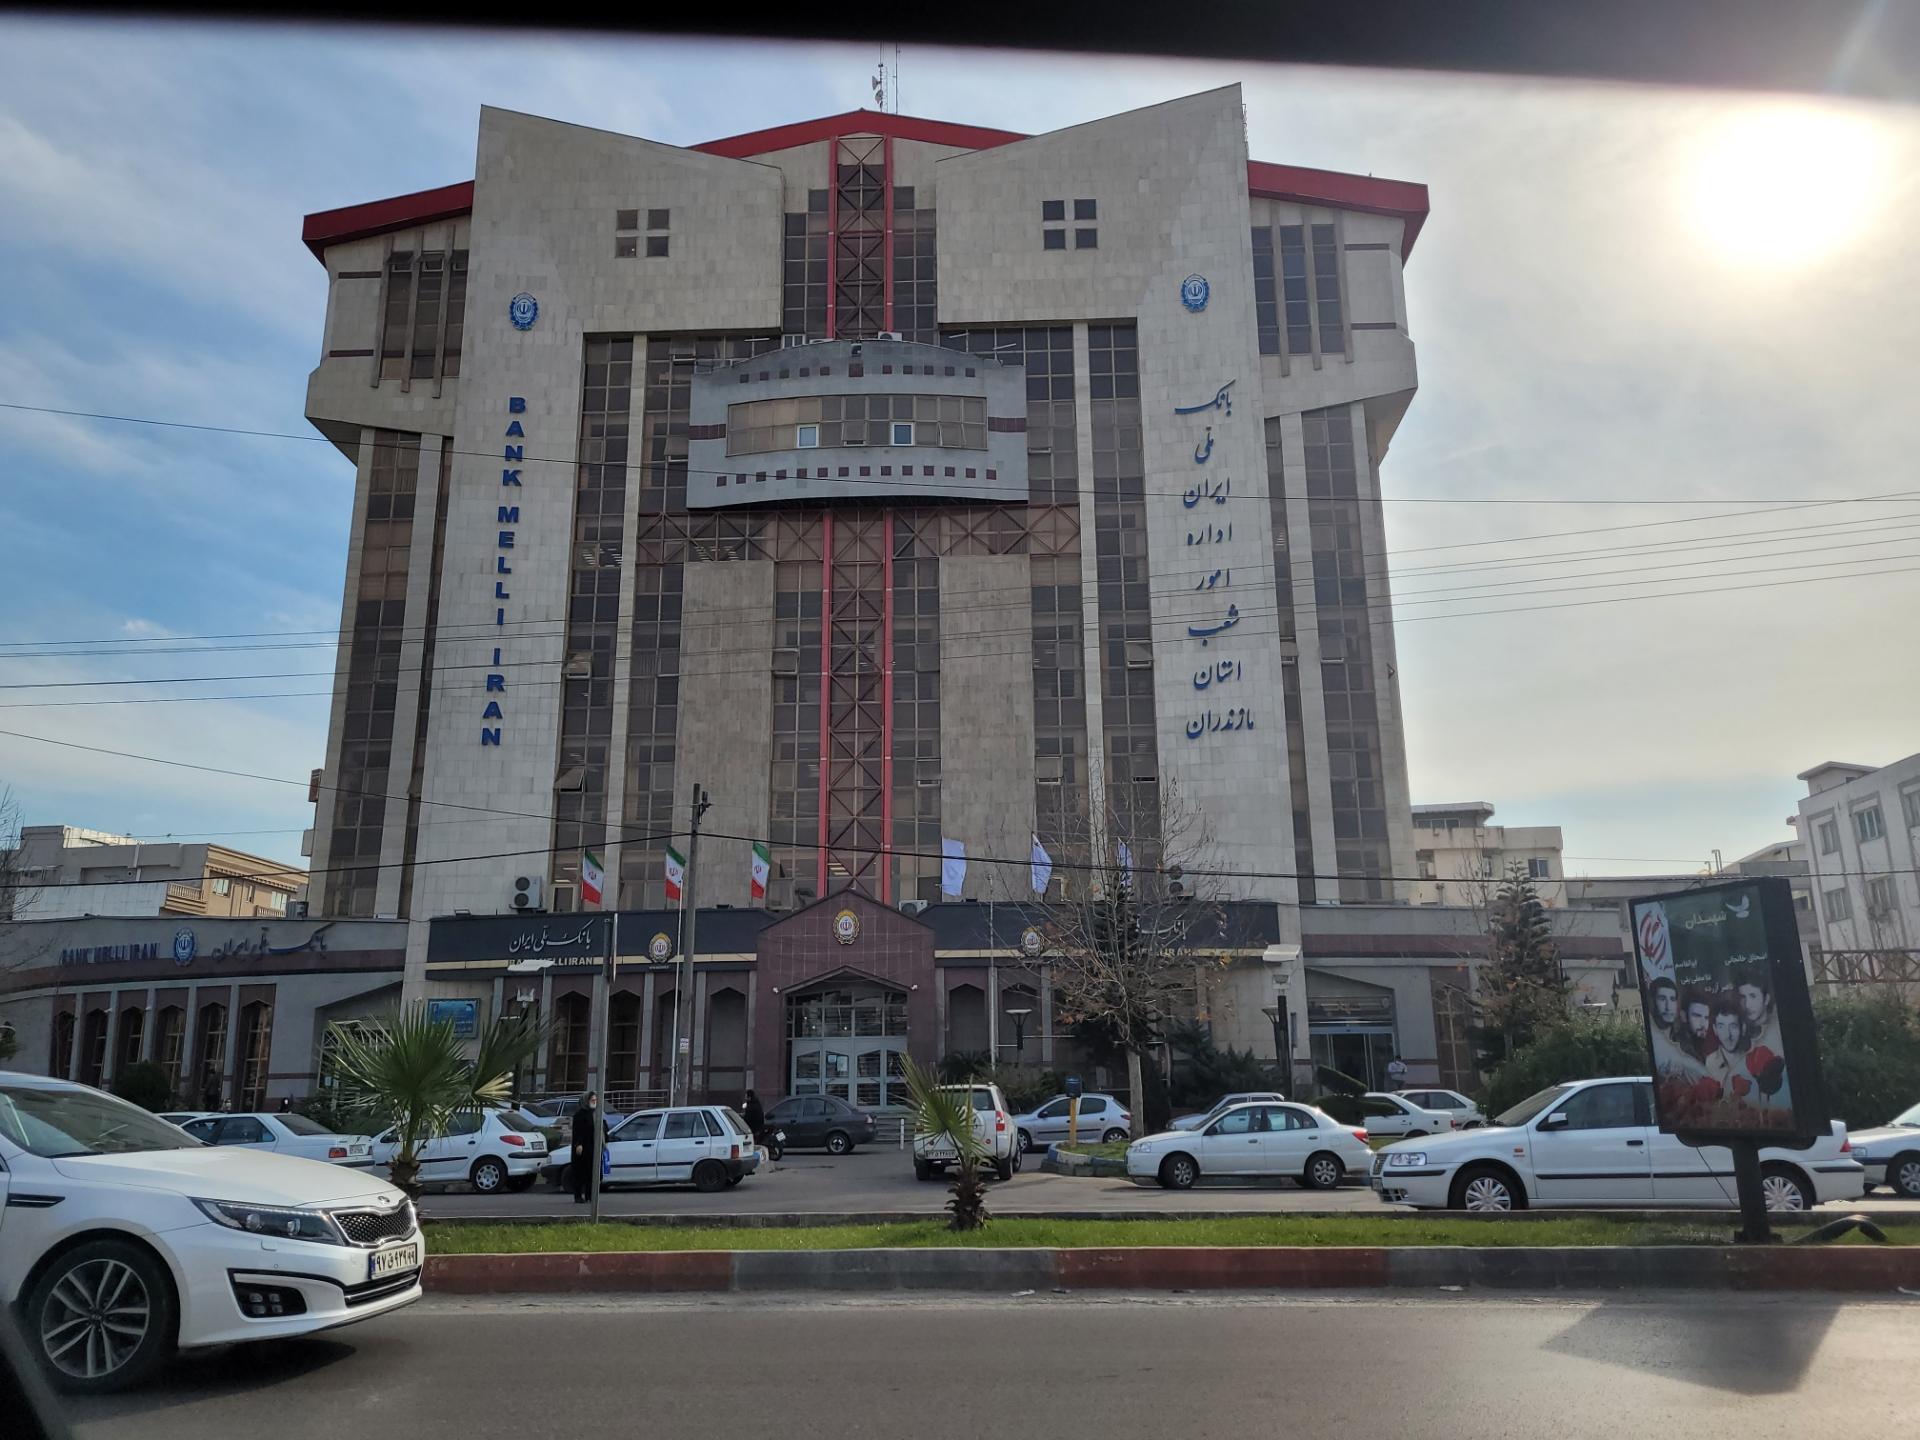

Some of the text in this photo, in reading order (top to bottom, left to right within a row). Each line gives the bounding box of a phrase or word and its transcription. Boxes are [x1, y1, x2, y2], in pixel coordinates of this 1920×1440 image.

[1174, 379, 1236, 417] بانک
[1183, 476, 1230, 509] ایران
[1187, 521, 1232, 546] اداره
[481, 397, 526, 746] BANK MELLI IRAN
[1195, 568, 1230, 590] امور
[1188, 603, 1241, 647] شعب
[1193, 660, 1241, 690] استان
[1186, 708, 1254, 739] مازندران
[547, 919, 594, 951] بانک
[1684, 910, 1728, 930] شهیدان
[509, 932, 534, 953] ایران
[568, 956, 592, 966] IRAN
